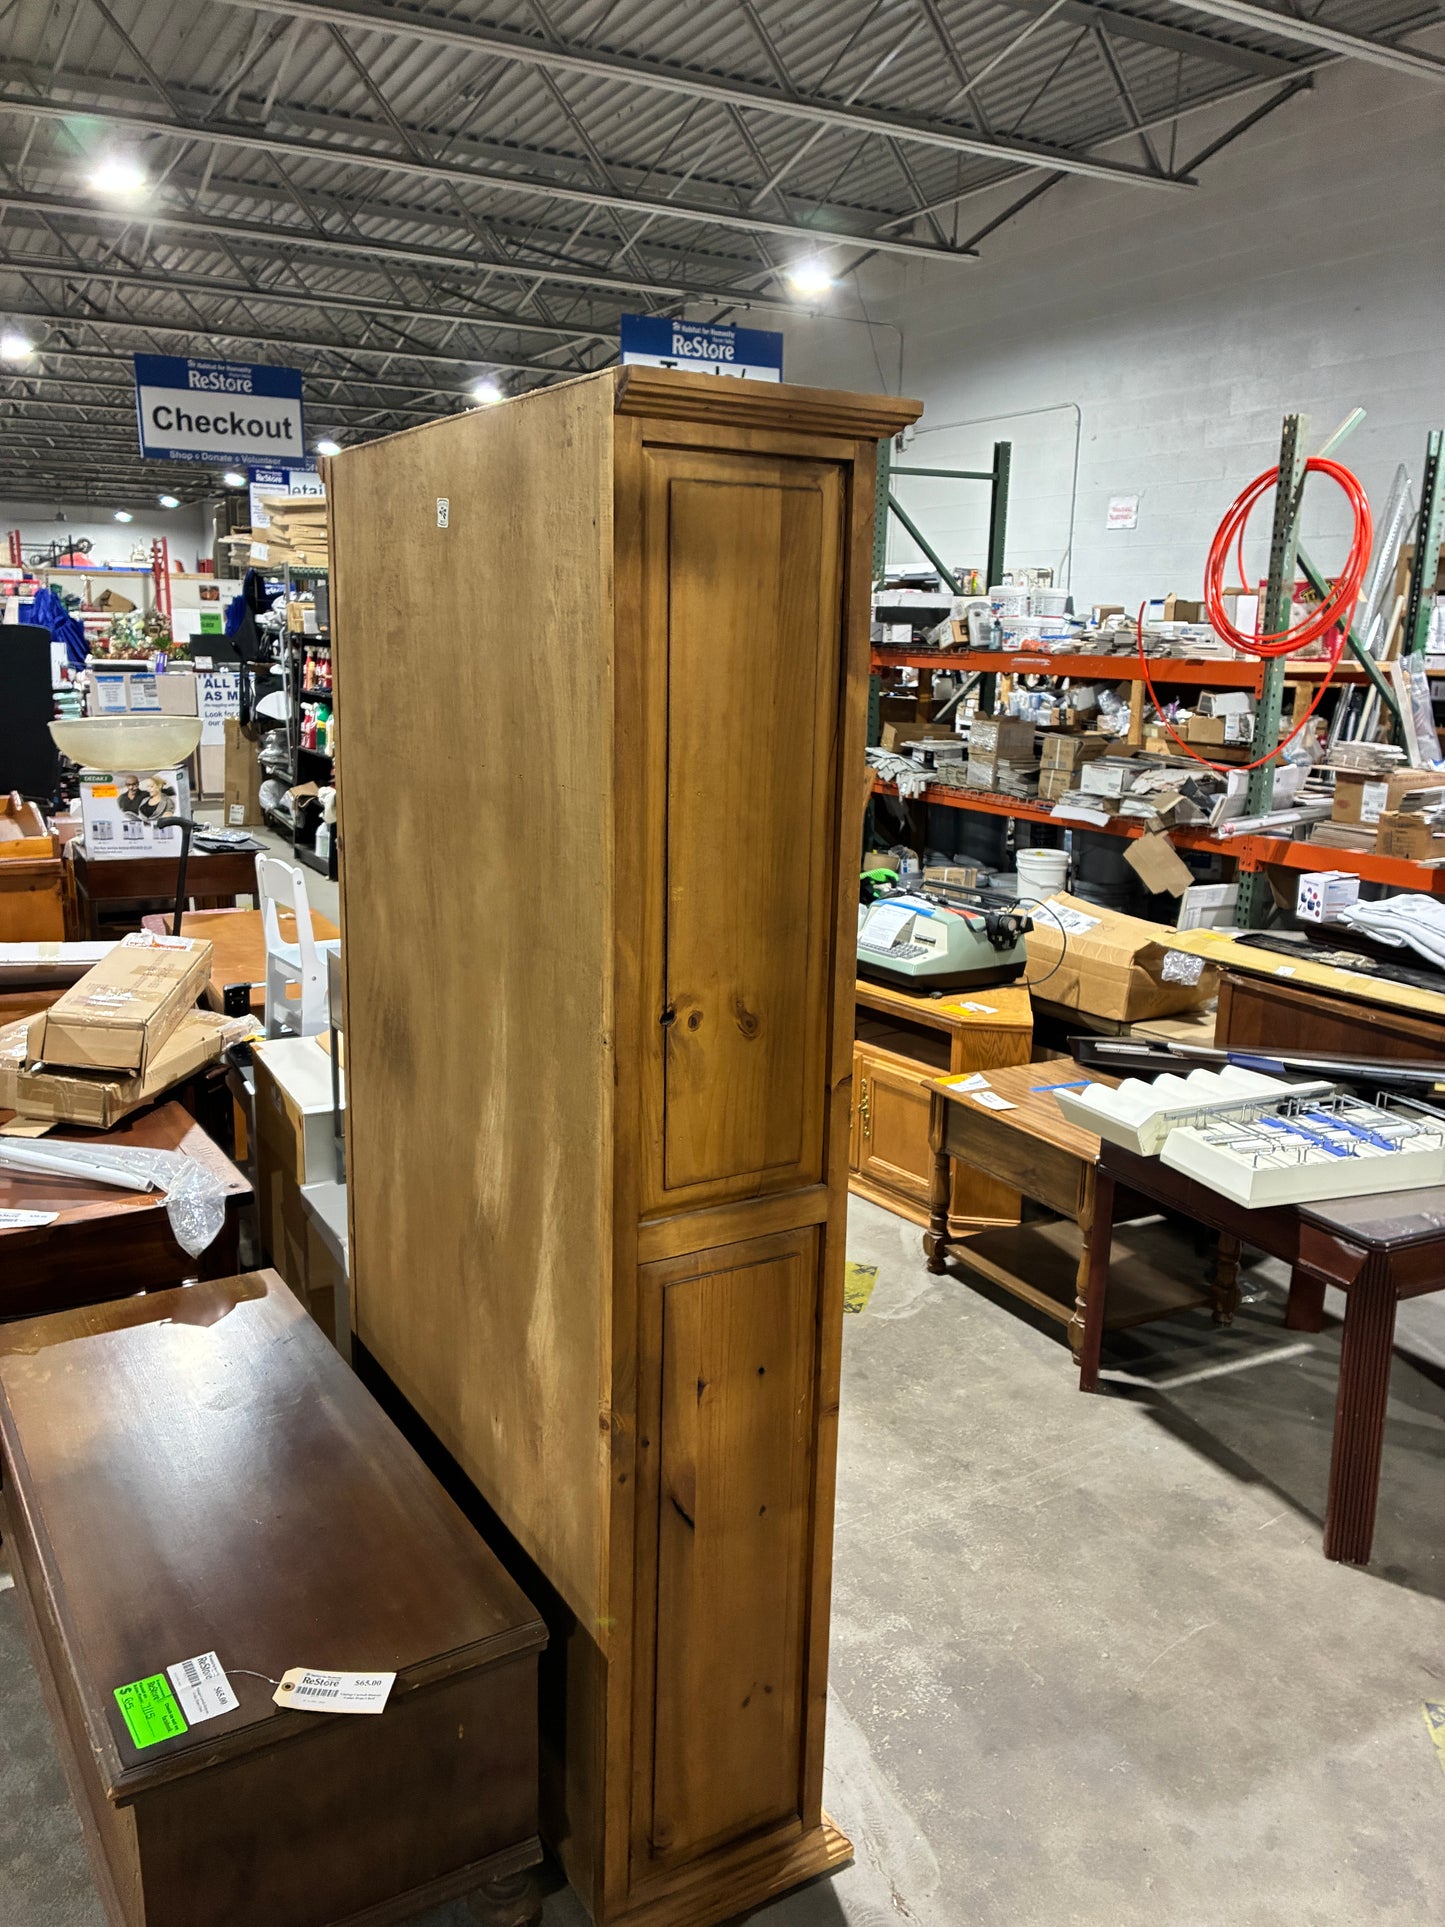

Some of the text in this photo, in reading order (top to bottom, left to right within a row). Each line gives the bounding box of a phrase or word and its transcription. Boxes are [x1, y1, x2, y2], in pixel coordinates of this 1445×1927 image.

[672, 334, 735, 361] ReStore
[188, 370, 253, 393] ReStore
[152, 405, 293, 440] Checkout
[169, 450, 281, 465] Shop Donate Volunteer
[204, 678, 230, 689] ALL
[204, 690, 223, 701] AS
[204, 710, 223, 718] Look
[302, 1676, 340, 1687] ReStore
[354, 1679, 382, 1687] $65.00
